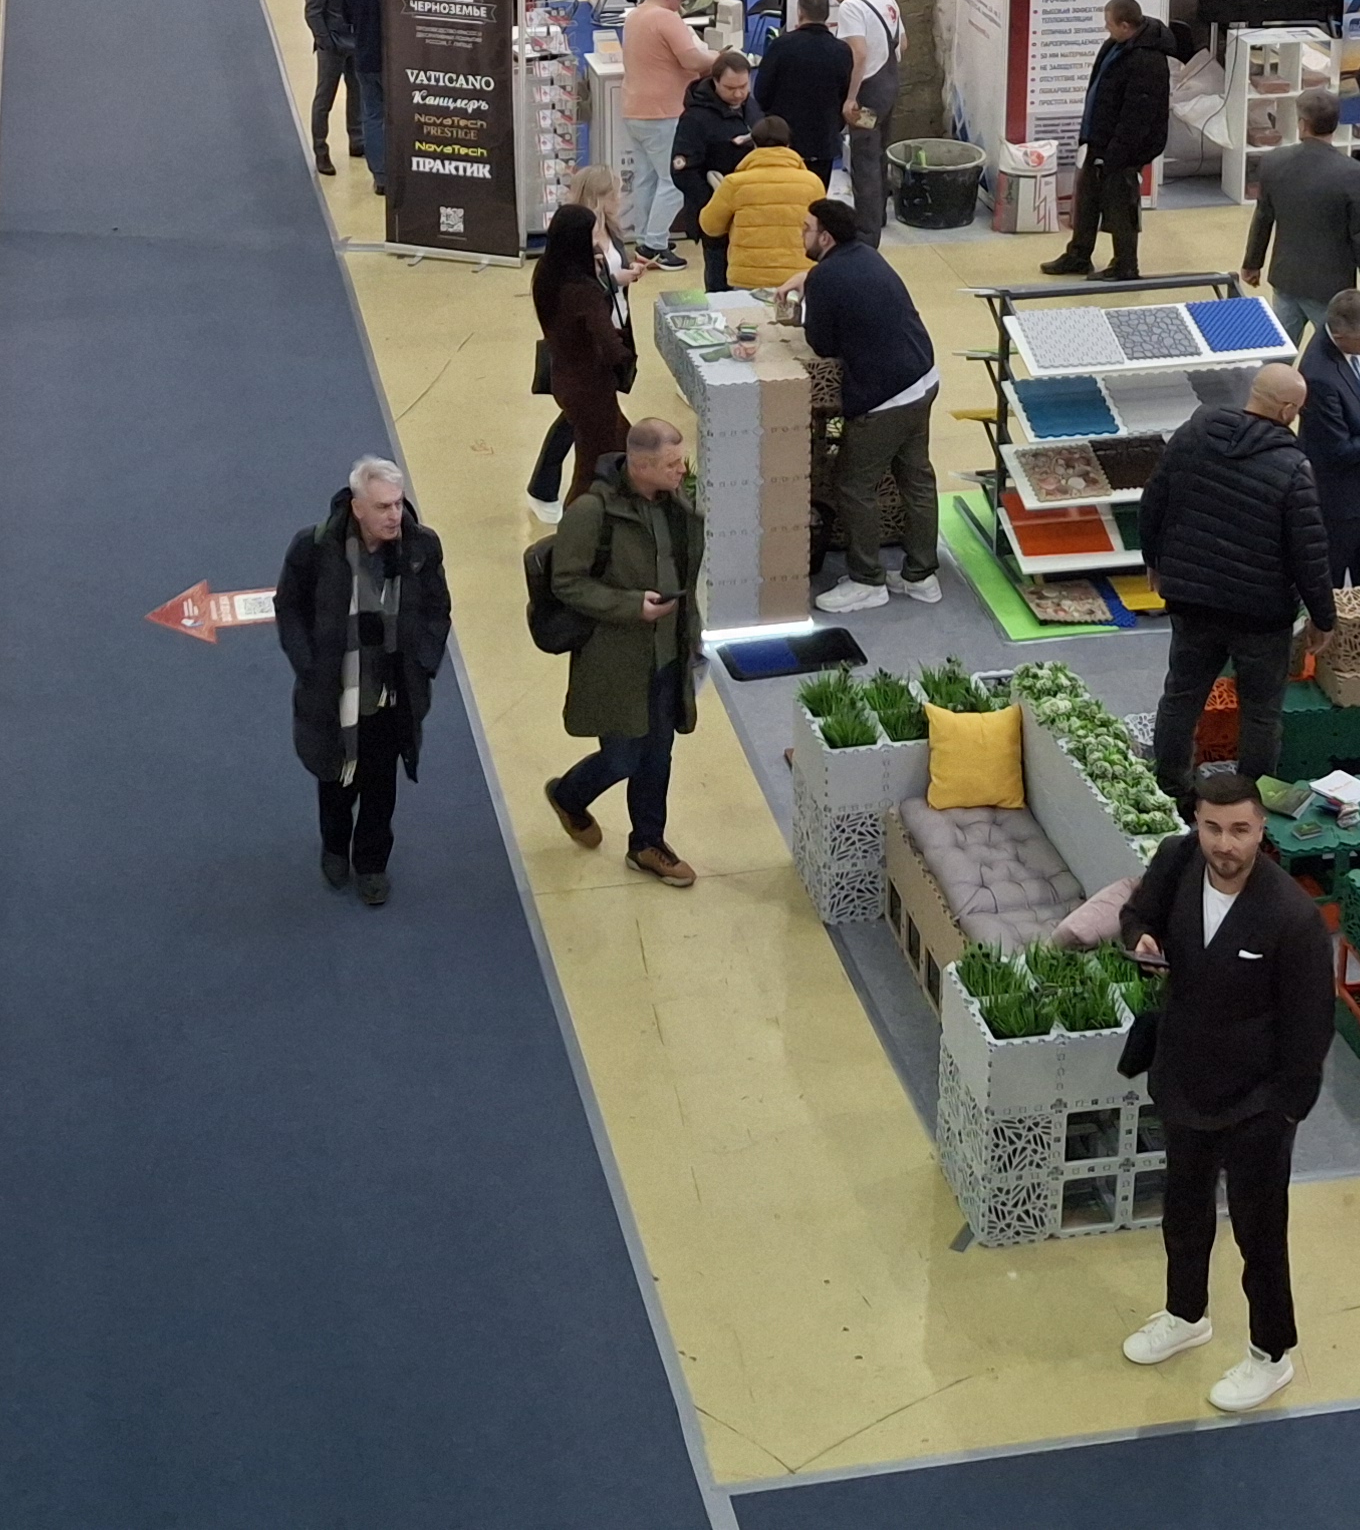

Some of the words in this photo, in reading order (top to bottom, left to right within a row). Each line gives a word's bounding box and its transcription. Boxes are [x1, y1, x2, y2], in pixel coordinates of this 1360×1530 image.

[409, 0, 488, 18] ЧЕРНОЗЕМЬЕ
[405, 68, 496, 91] VATICANO
[423, 124, 478, 140] PRESTIGE
[412, 156, 492, 179] ПРАКТИК
